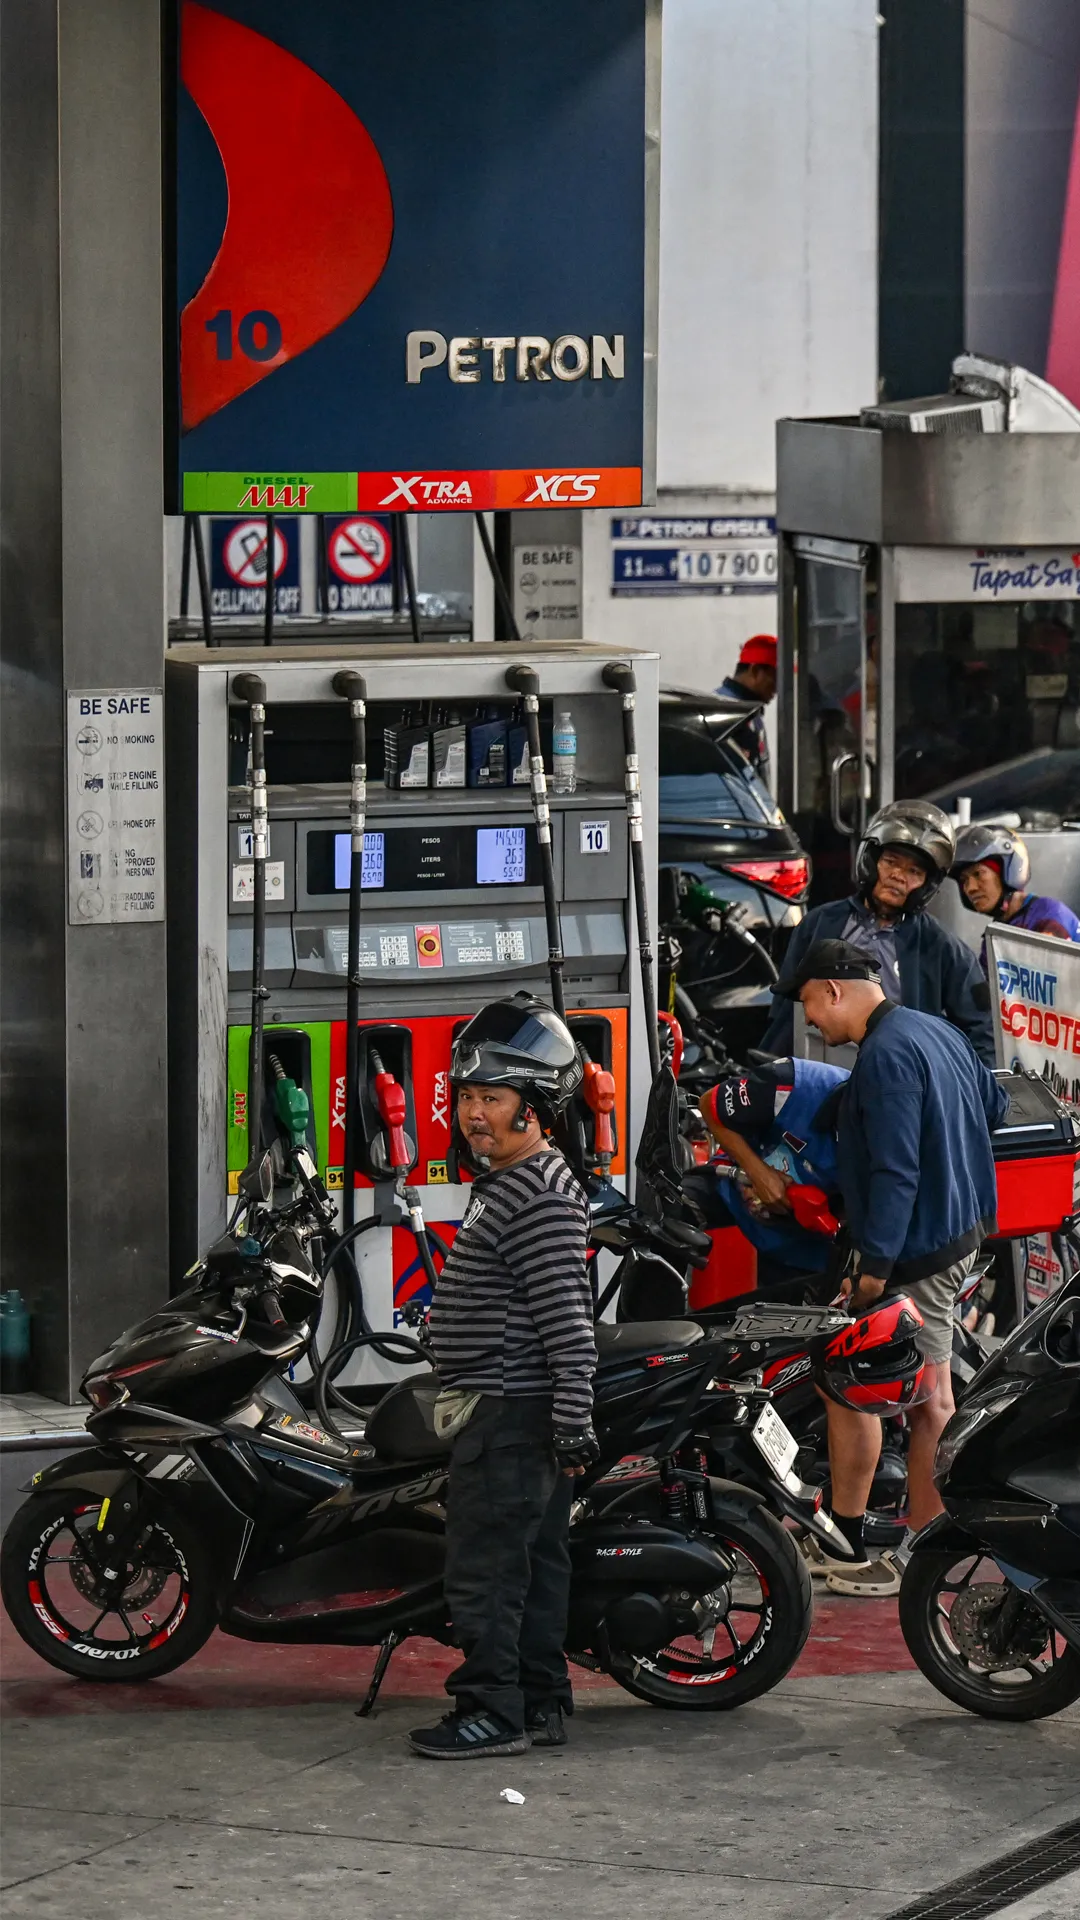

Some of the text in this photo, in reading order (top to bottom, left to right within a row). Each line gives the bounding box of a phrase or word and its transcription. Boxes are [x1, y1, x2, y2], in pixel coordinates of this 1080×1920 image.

[205, 310, 282, 363] 10
[405, 330, 625, 384] PETRON
[244, 476, 309, 486] DIESEL
[377, 476, 473, 506] XTRA
[523, 475, 601, 503] XCS
[238, 484, 314, 509] MAX
[427, 497, 473, 505] ADVANCE
[639, 519, 709, 537] PETRON
[522, 551, 573, 565] BE SAFE
[623, 556, 644, 578] 11
[969, 561, 1043, 597] Tapat
[279, 587, 300, 613] OFF
[341, 585, 393, 611] SMOKIN
[80, 697, 151, 716] BE SAFE
[107, 736, 119, 745] NO
[129, 770, 158, 780] ENGINE
[132, 780, 159, 790] FILLING
[144, 818, 156, 828] OFF
[245, 834, 252, 855] 1
[586, 829, 603, 850] 10
[142, 867, 156, 876] ONLY
[997, 960, 1058, 1007] SPRINT
[332, 1076, 346, 1132] XTRA
[431, 1071, 448, 1130] XTRA
[725, 1084, 735, 1117] XTRA
[739, 1080, 752, 1106] XCS
[33, 1602, 65, 1636] 155
[72, 1643, 141, 1661] aerox
